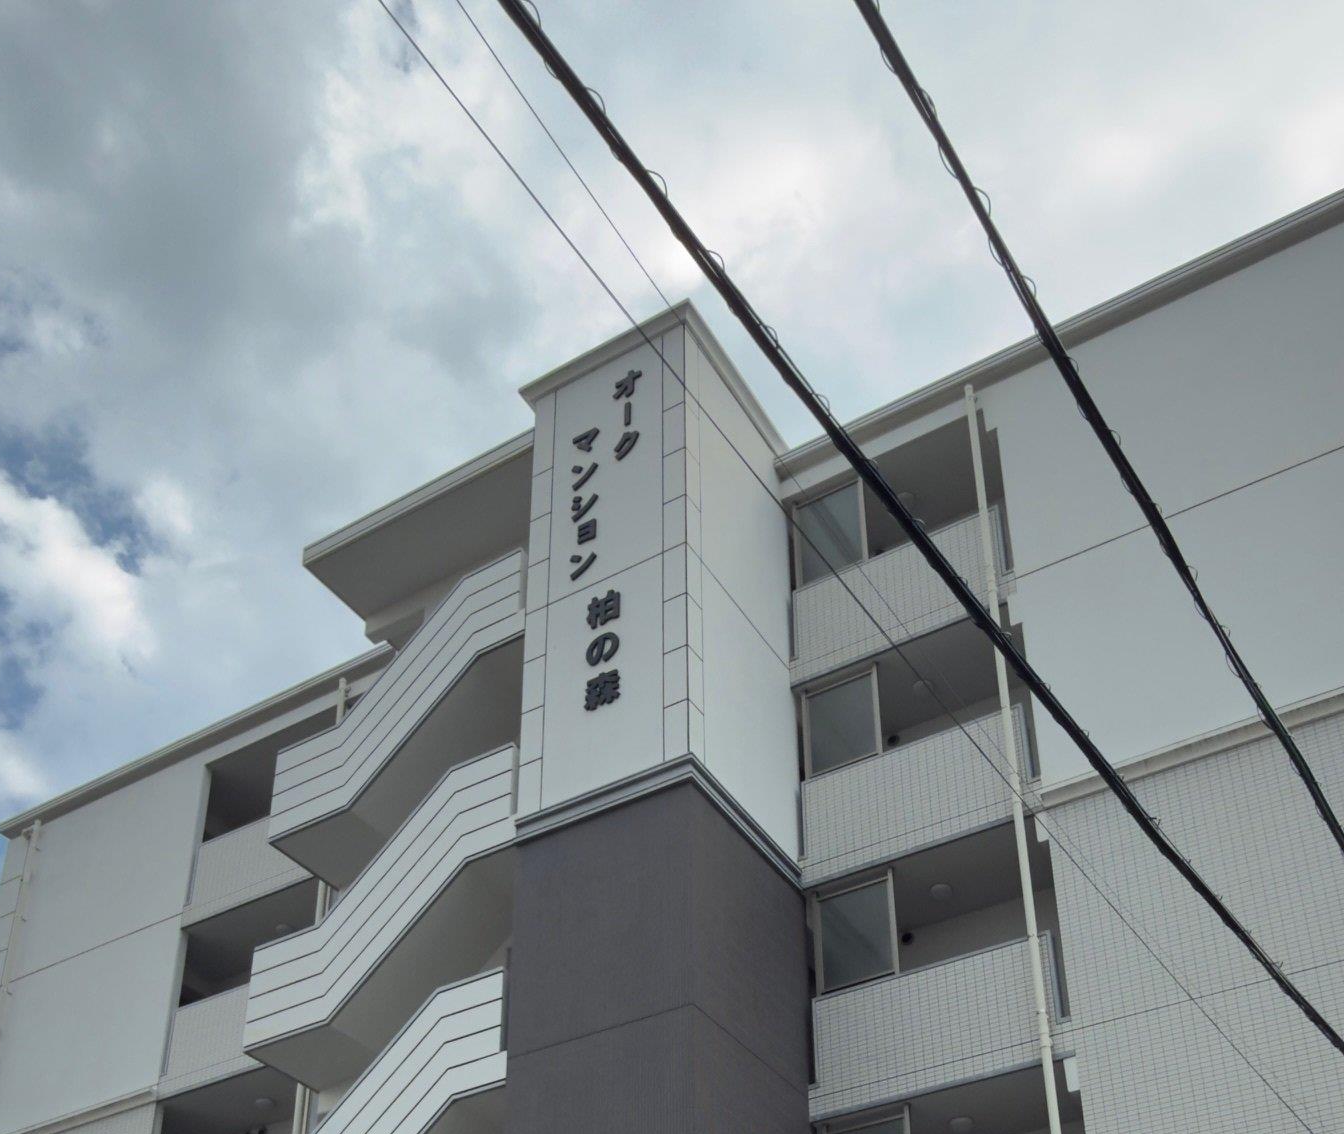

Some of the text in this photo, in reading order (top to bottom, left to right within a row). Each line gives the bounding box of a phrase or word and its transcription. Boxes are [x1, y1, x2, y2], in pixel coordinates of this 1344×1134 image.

[613, 370, 642, 461] オーク
[571, 427, 599, 581] マンション
[584, 589, 621, 711] 柏の森
